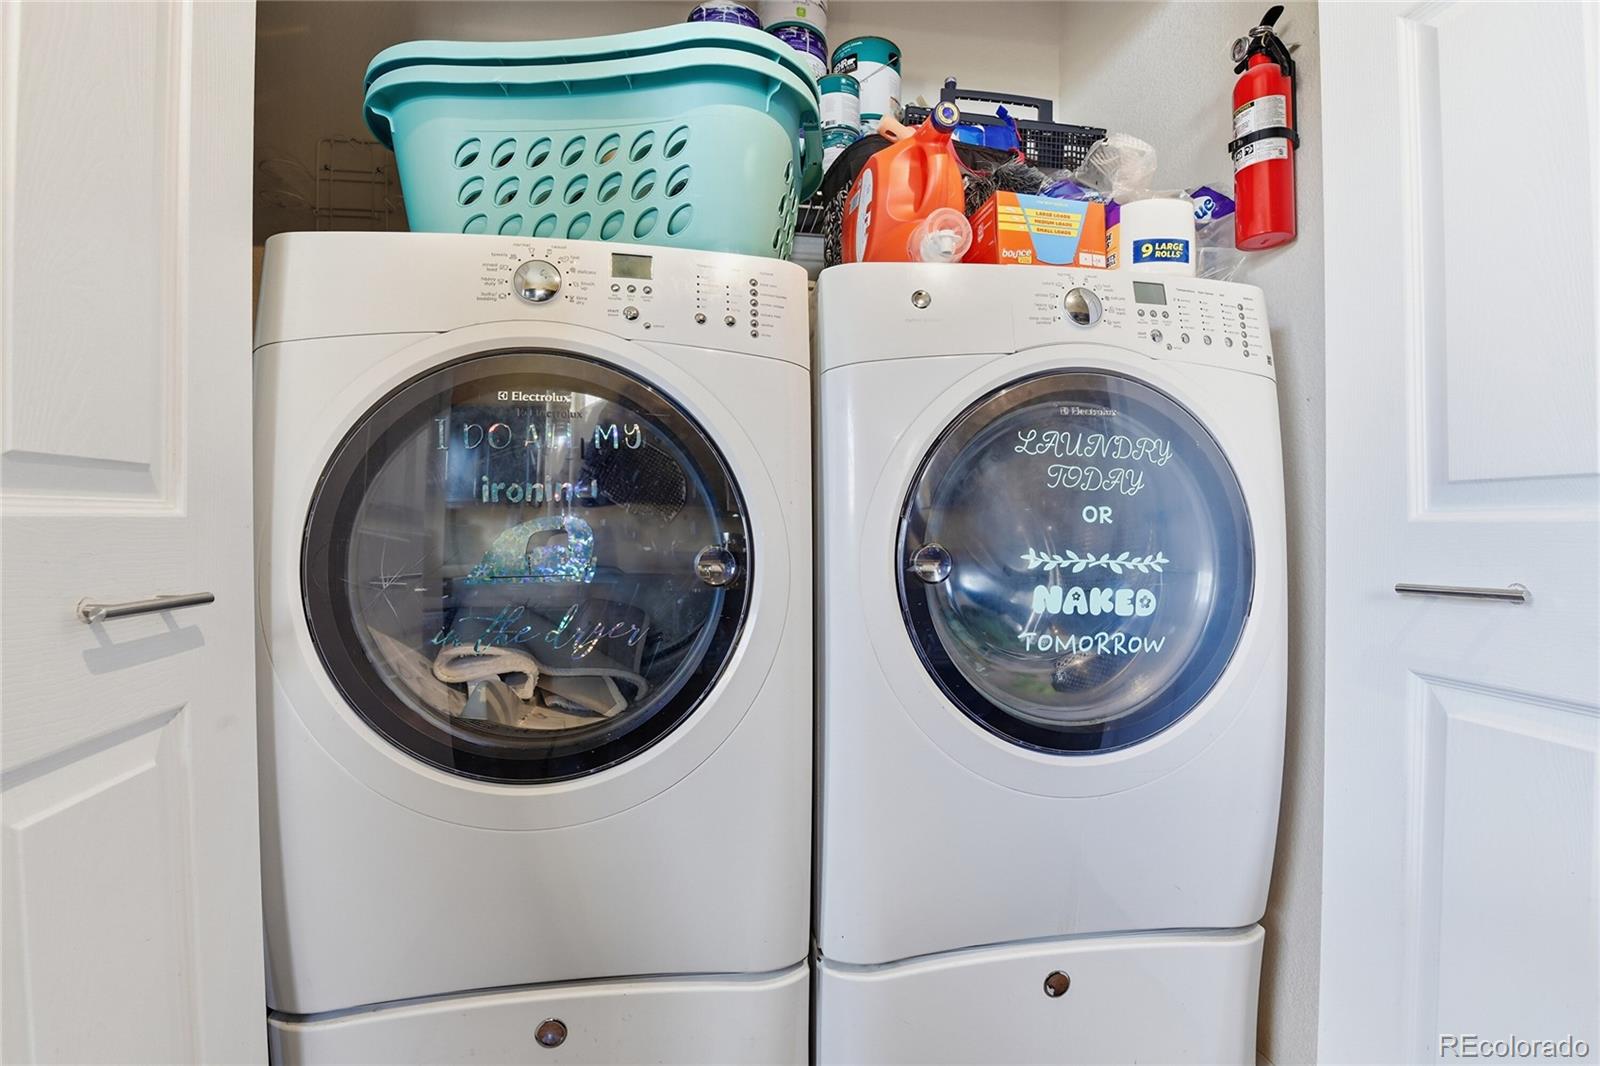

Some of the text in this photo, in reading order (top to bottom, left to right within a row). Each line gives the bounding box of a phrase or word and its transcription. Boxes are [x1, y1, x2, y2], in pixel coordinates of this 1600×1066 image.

[1194, 197, 1215, 219] ue
[1034, 218, 1055, 226] MEDIUM
[1001, 249, 1032, 259] bounce
[1141, 243, 1184, 257] 9 LARGE
[1155, 250, 1182, 258] ROLLS
[512, 391, 571, 403] Electrolux
[435, 418, 449, 450] I
[463, 422, 512, 449] DO
[594, 423, 642, 450] MY
[1014, 429, 1173, 467] LAUNDRY
[1047, 464, 1145, 496] TODAY
[1082, 506, 1113, 524] OR
[1031, 585, 1157, 617] NAKED
[459, 604, 541, 653] the
[545, 603, 650, 660] dryer
[1017, 631, 1166, 655] TOMORROW
